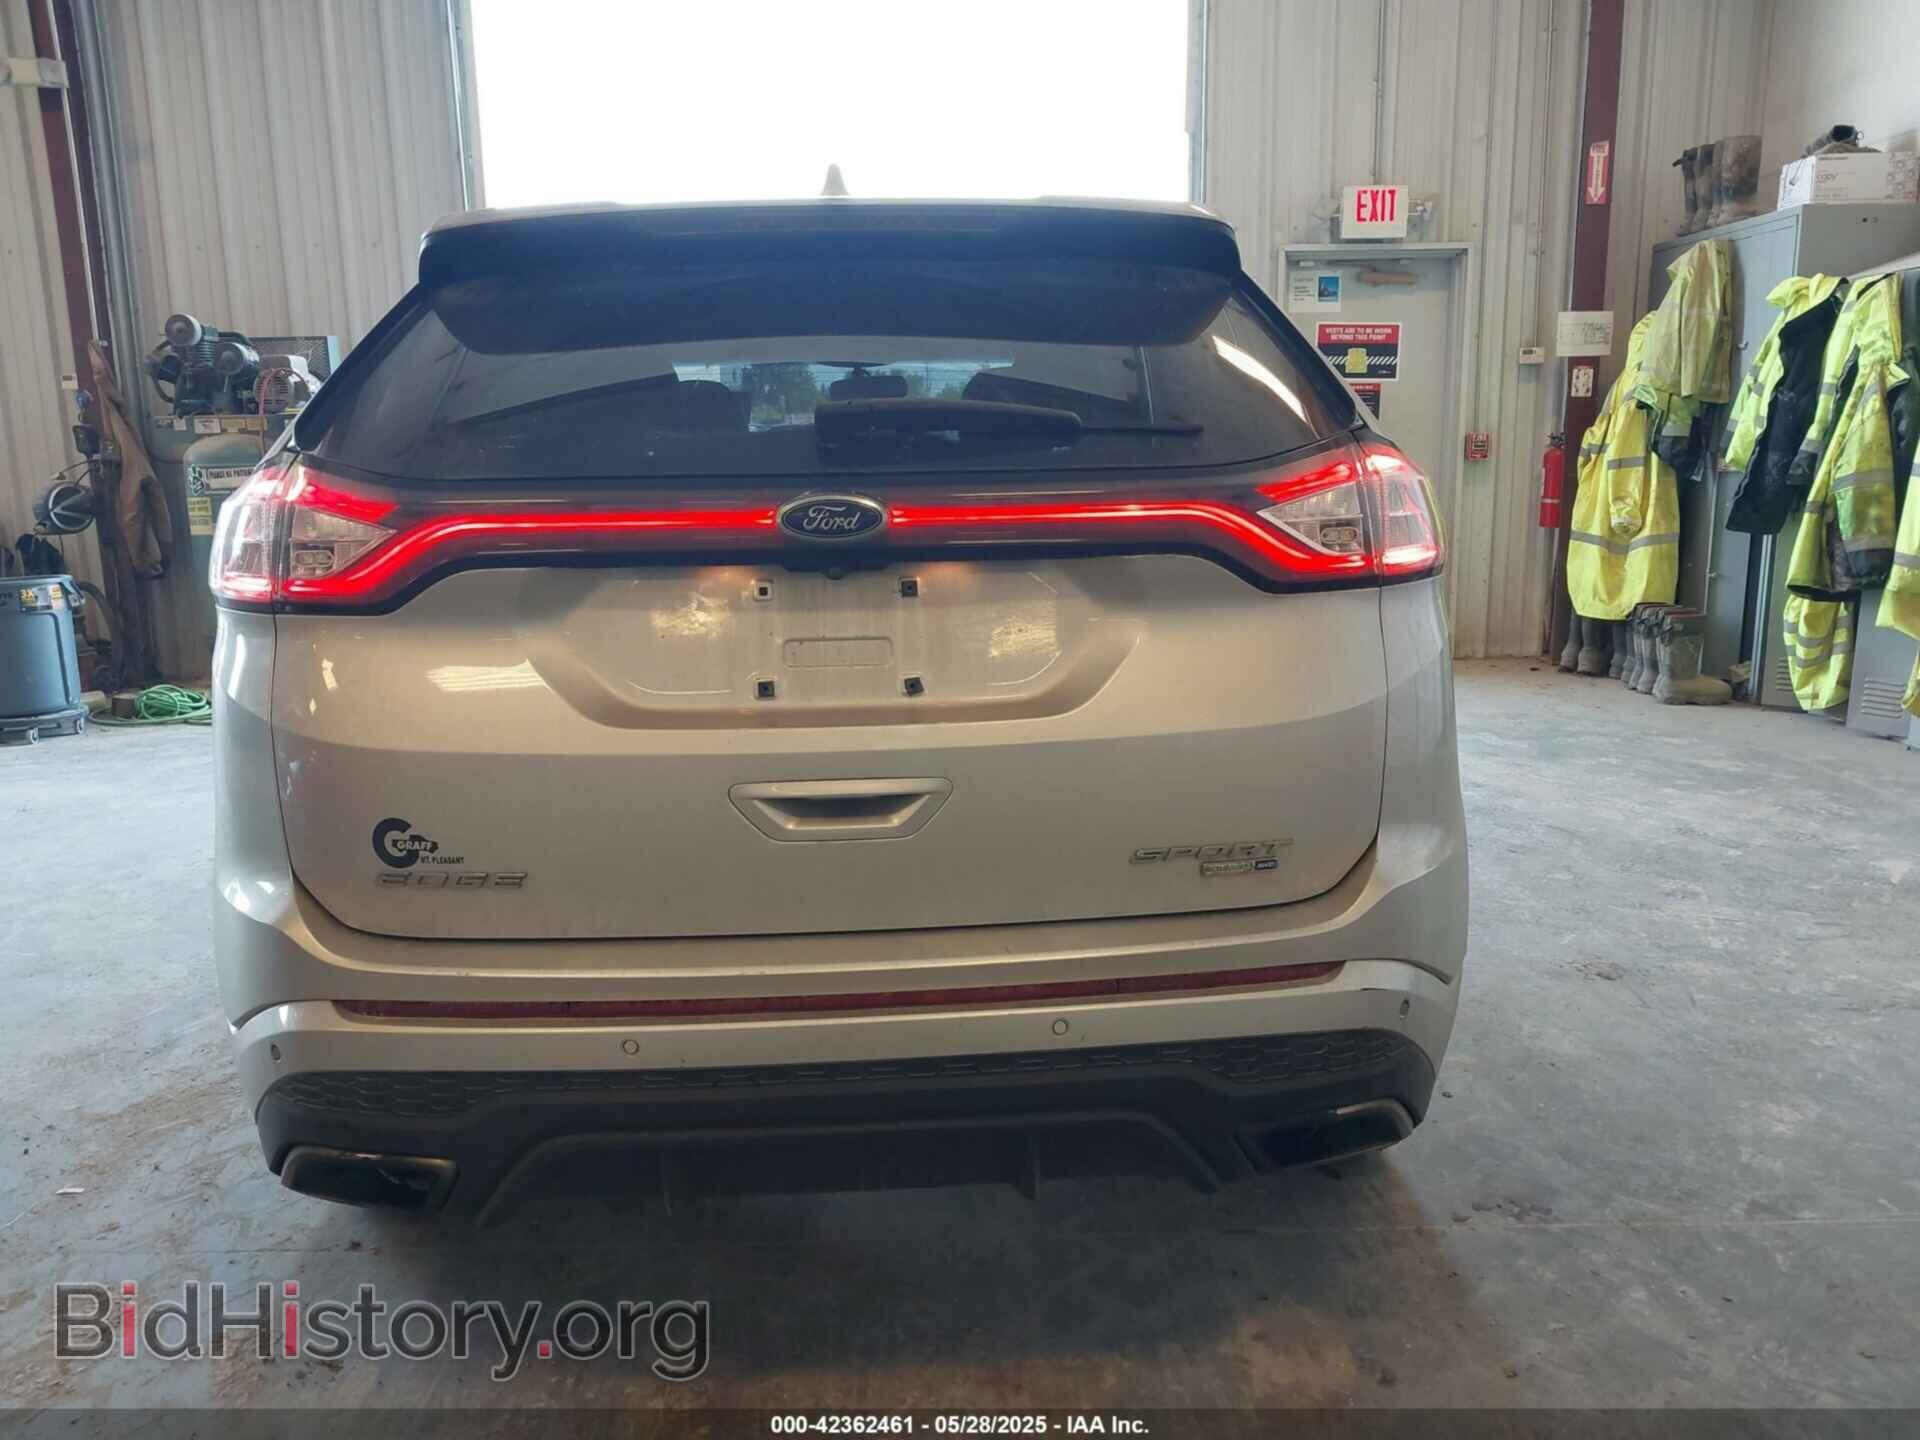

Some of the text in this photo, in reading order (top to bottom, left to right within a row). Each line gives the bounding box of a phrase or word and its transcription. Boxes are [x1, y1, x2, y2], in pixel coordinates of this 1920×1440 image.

[1355, 188, 1397, 223] EXIT
[802, 506, 861, 531] Ford
[396, 840, 433, 851] GRAFF
[1130, 837, 1295, 864] SPORT
[432, 855, 465, 865] PLEASANT
[374, 871, 528, 889] EDGE
